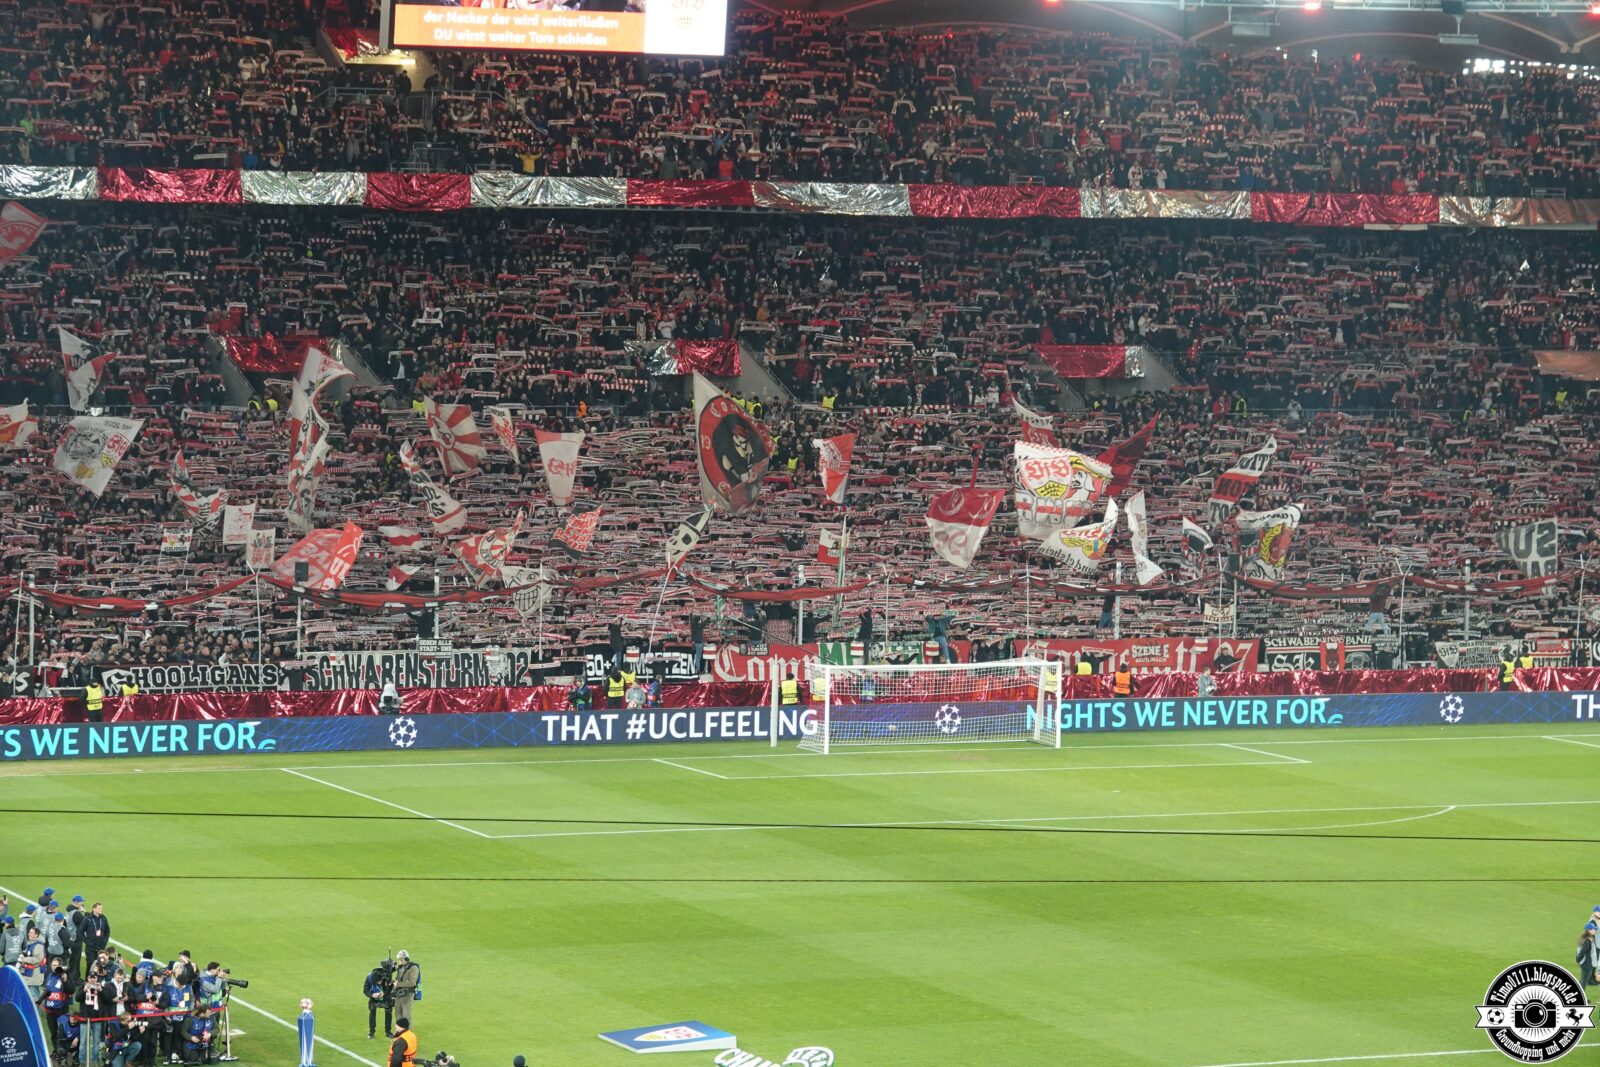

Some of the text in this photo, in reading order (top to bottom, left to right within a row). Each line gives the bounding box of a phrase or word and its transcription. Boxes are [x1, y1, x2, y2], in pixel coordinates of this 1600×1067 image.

[423, 12, 443, 23] der
[446, 13, 489, 24] Neckar
[513, 15, 539, 27] wird
[433, 29, 608, 46] DU wirst weiter Tore schießen
[130, 664, 278, 688] HOOLIGANS
[542, 709, 818, 741] THAT #UCLFEELING
[1027, 702, 1126, 730] NIGHTS
[1133, 701, 1175, 727] WE
[1183, 699, 1272, 725] NEVER
[0, 729, 22, 757] S
[30, 727, 80, 755] WE
[89, 724, 187, 754] NEVER
